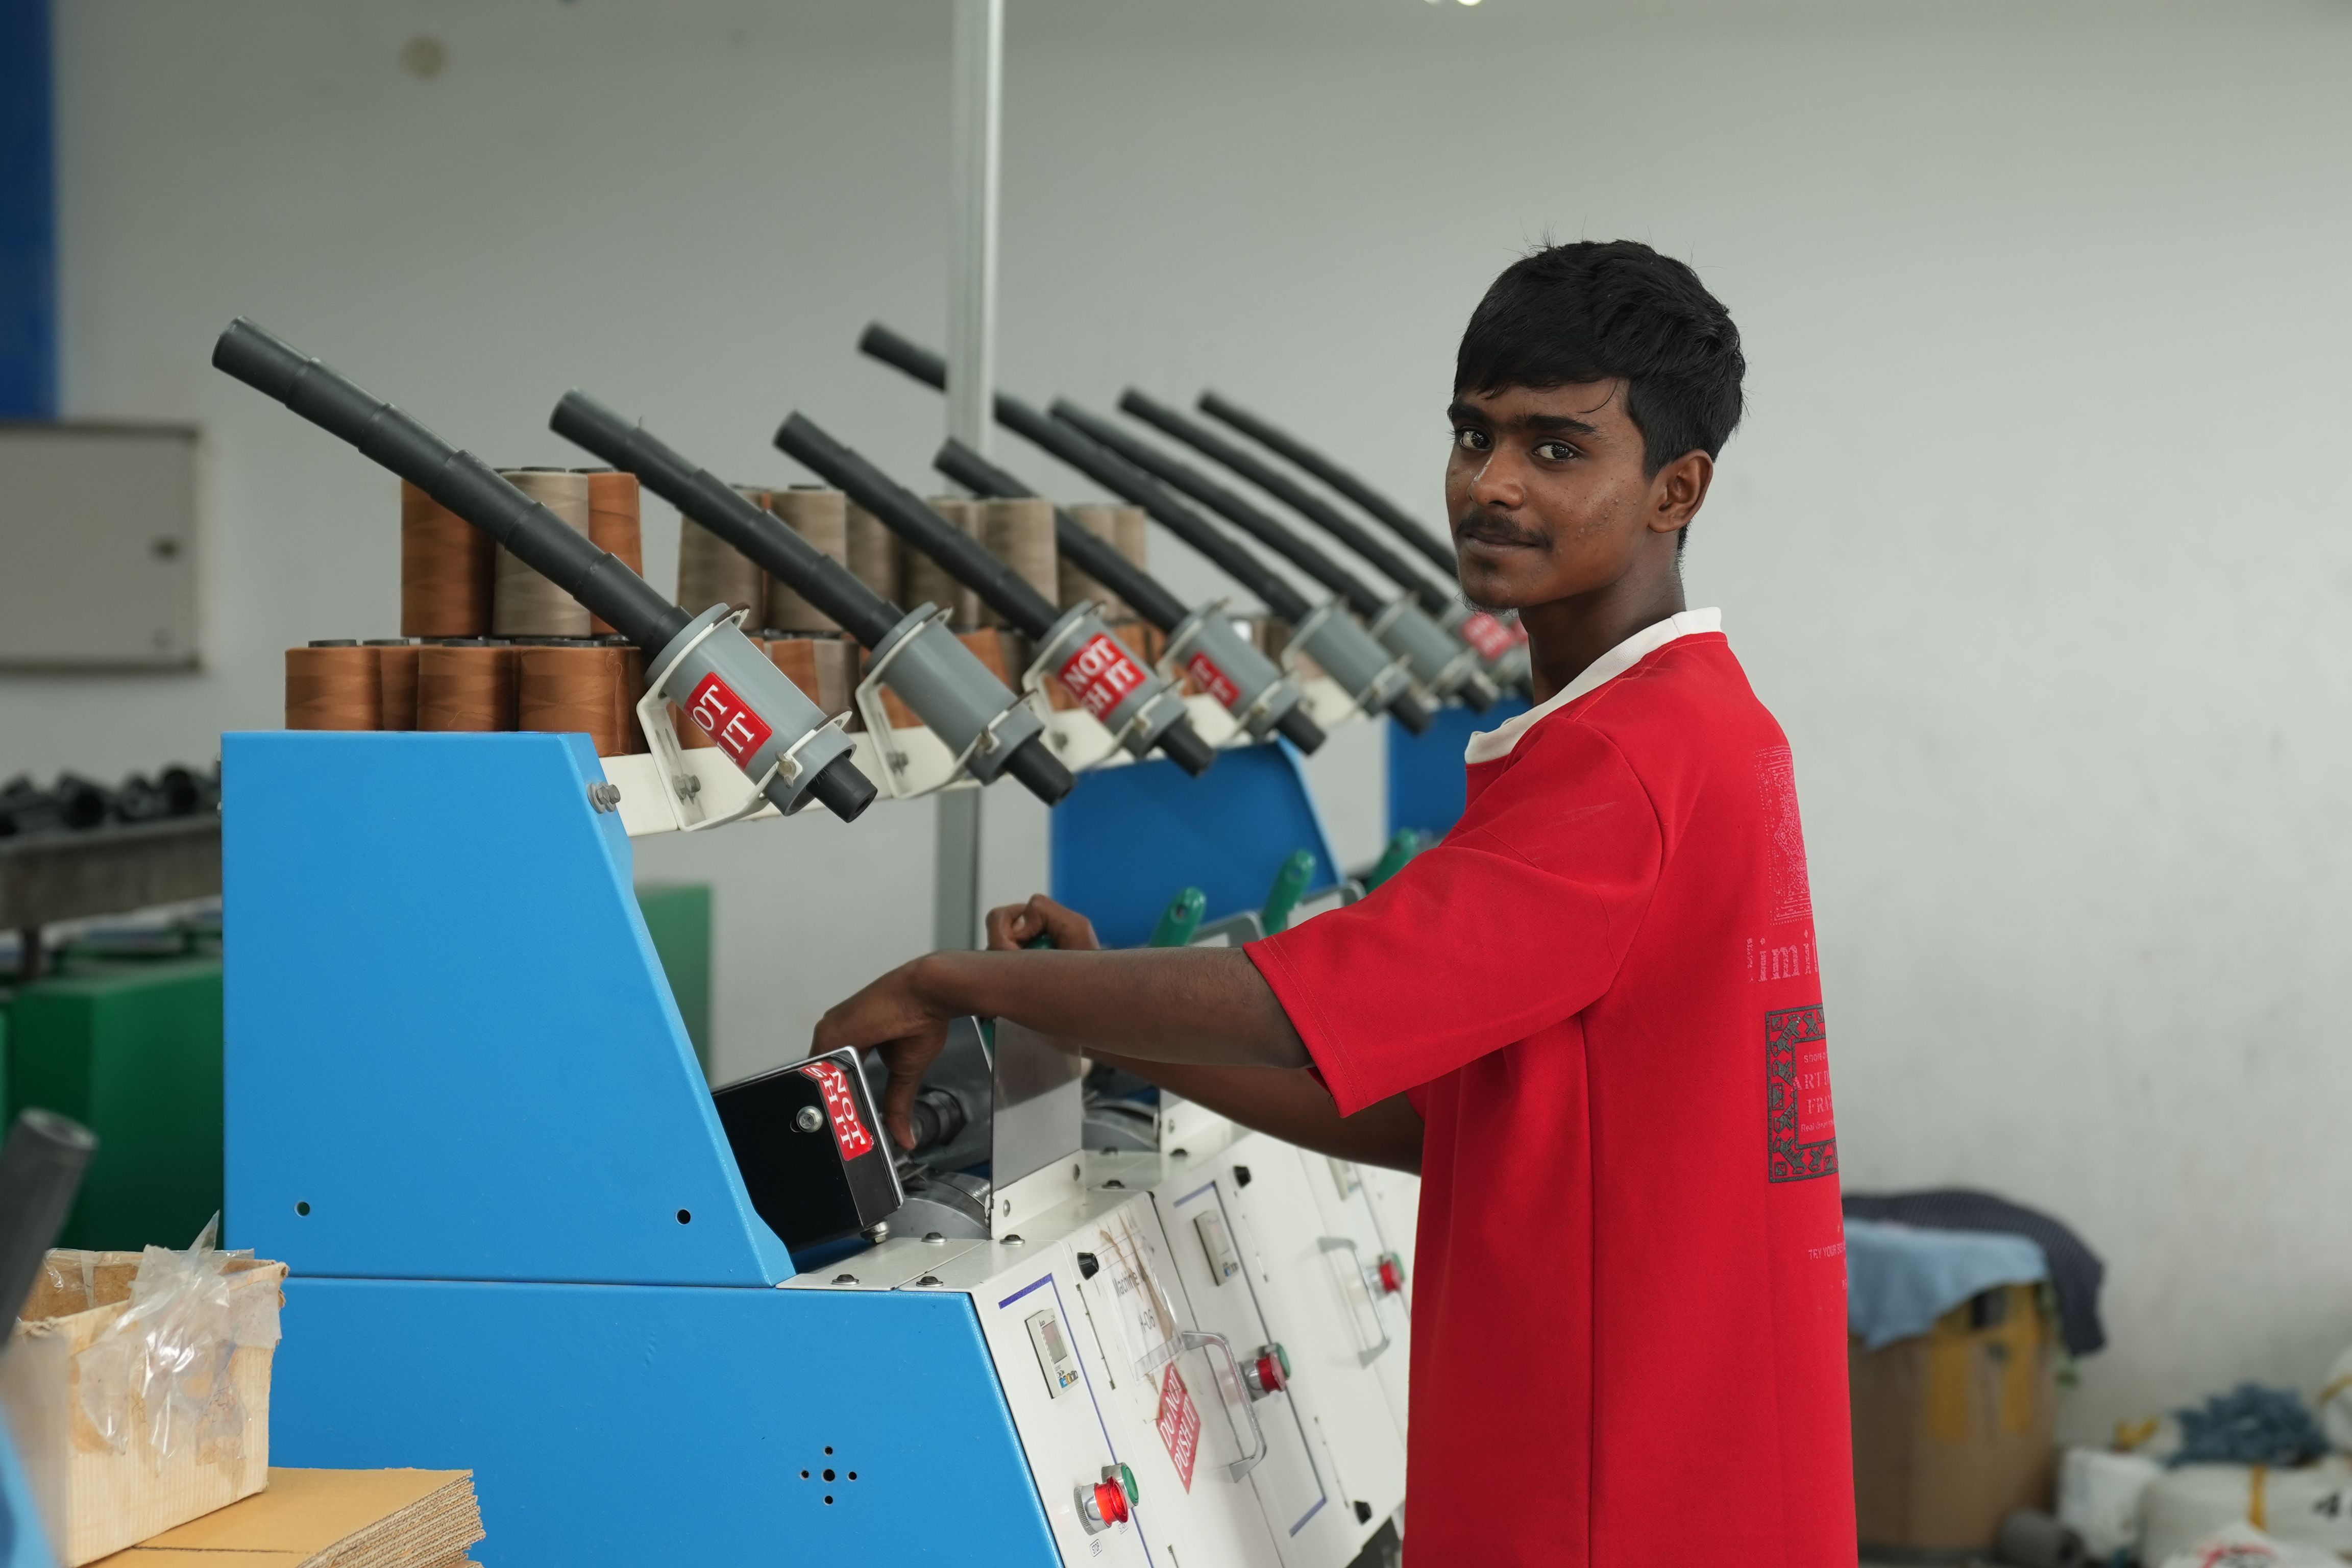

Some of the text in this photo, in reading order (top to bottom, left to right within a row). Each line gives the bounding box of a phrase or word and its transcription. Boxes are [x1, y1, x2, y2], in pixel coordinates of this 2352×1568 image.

[1063, 637, 1117, 691] NOT
[1104, 658, 1136, 691] IT
[690, 684, 728, 737] OT
[721, 711, 754, 753] IT
[805, 1062, 853, 1149] SH IT
[829, 1070, 866, 1145] NOT
[1112, 1270, 1140, 1299] Machine
[1166, 1366, 1181, 1420] NOT
[1174, 1395, 1196, 1481] PUSH IT
